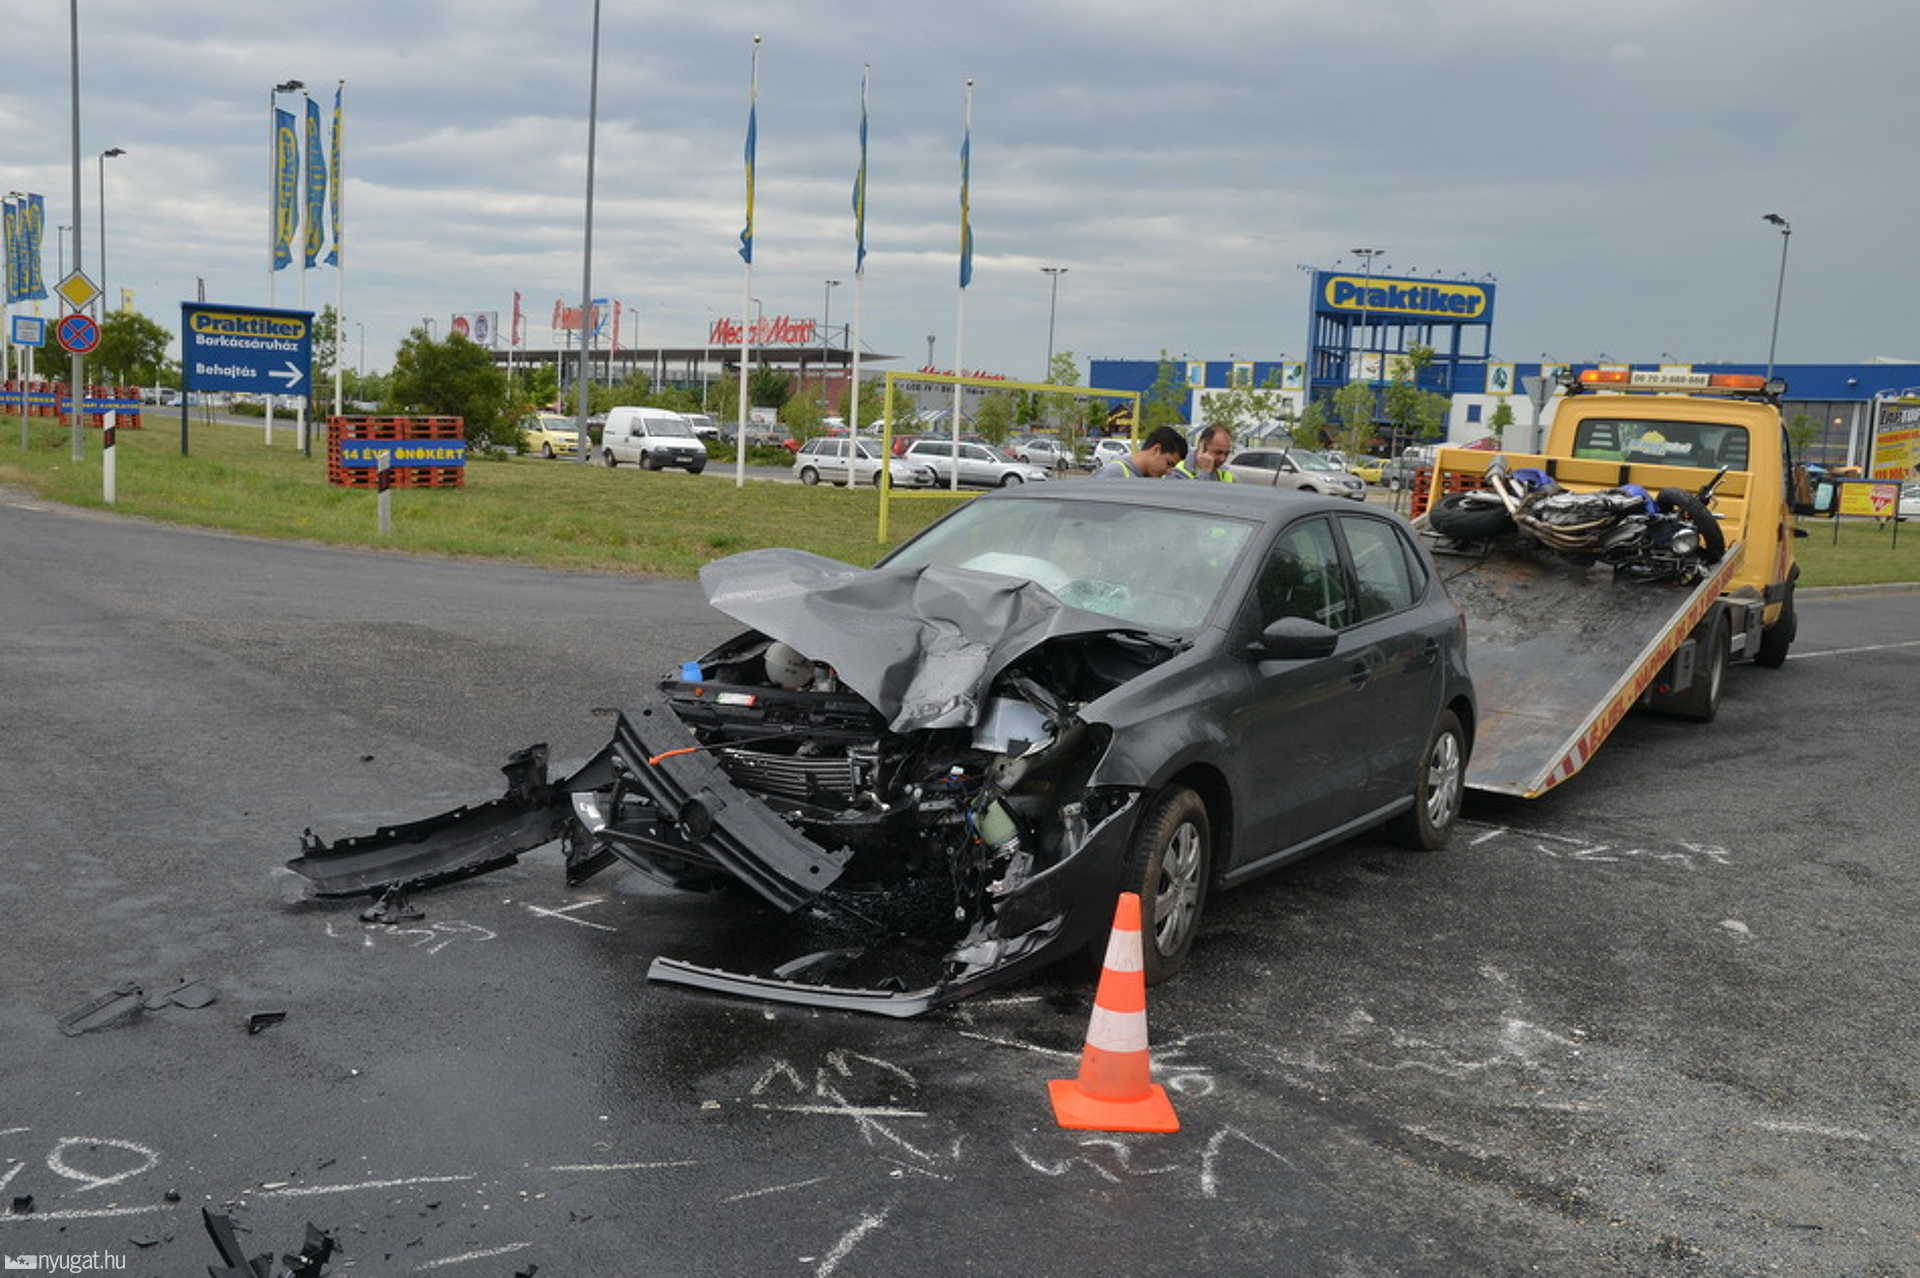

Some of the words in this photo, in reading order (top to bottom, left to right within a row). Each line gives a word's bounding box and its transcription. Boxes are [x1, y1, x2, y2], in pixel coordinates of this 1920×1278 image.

[1334, 281, 1481, 314] Praktiker
[195, 314, 302, 336] Praktiker
[195, 334, 299, 352] Barkácsáruház
[195, 362, 257, 379] Behajtás
[342, 449, 358, 460] 14
